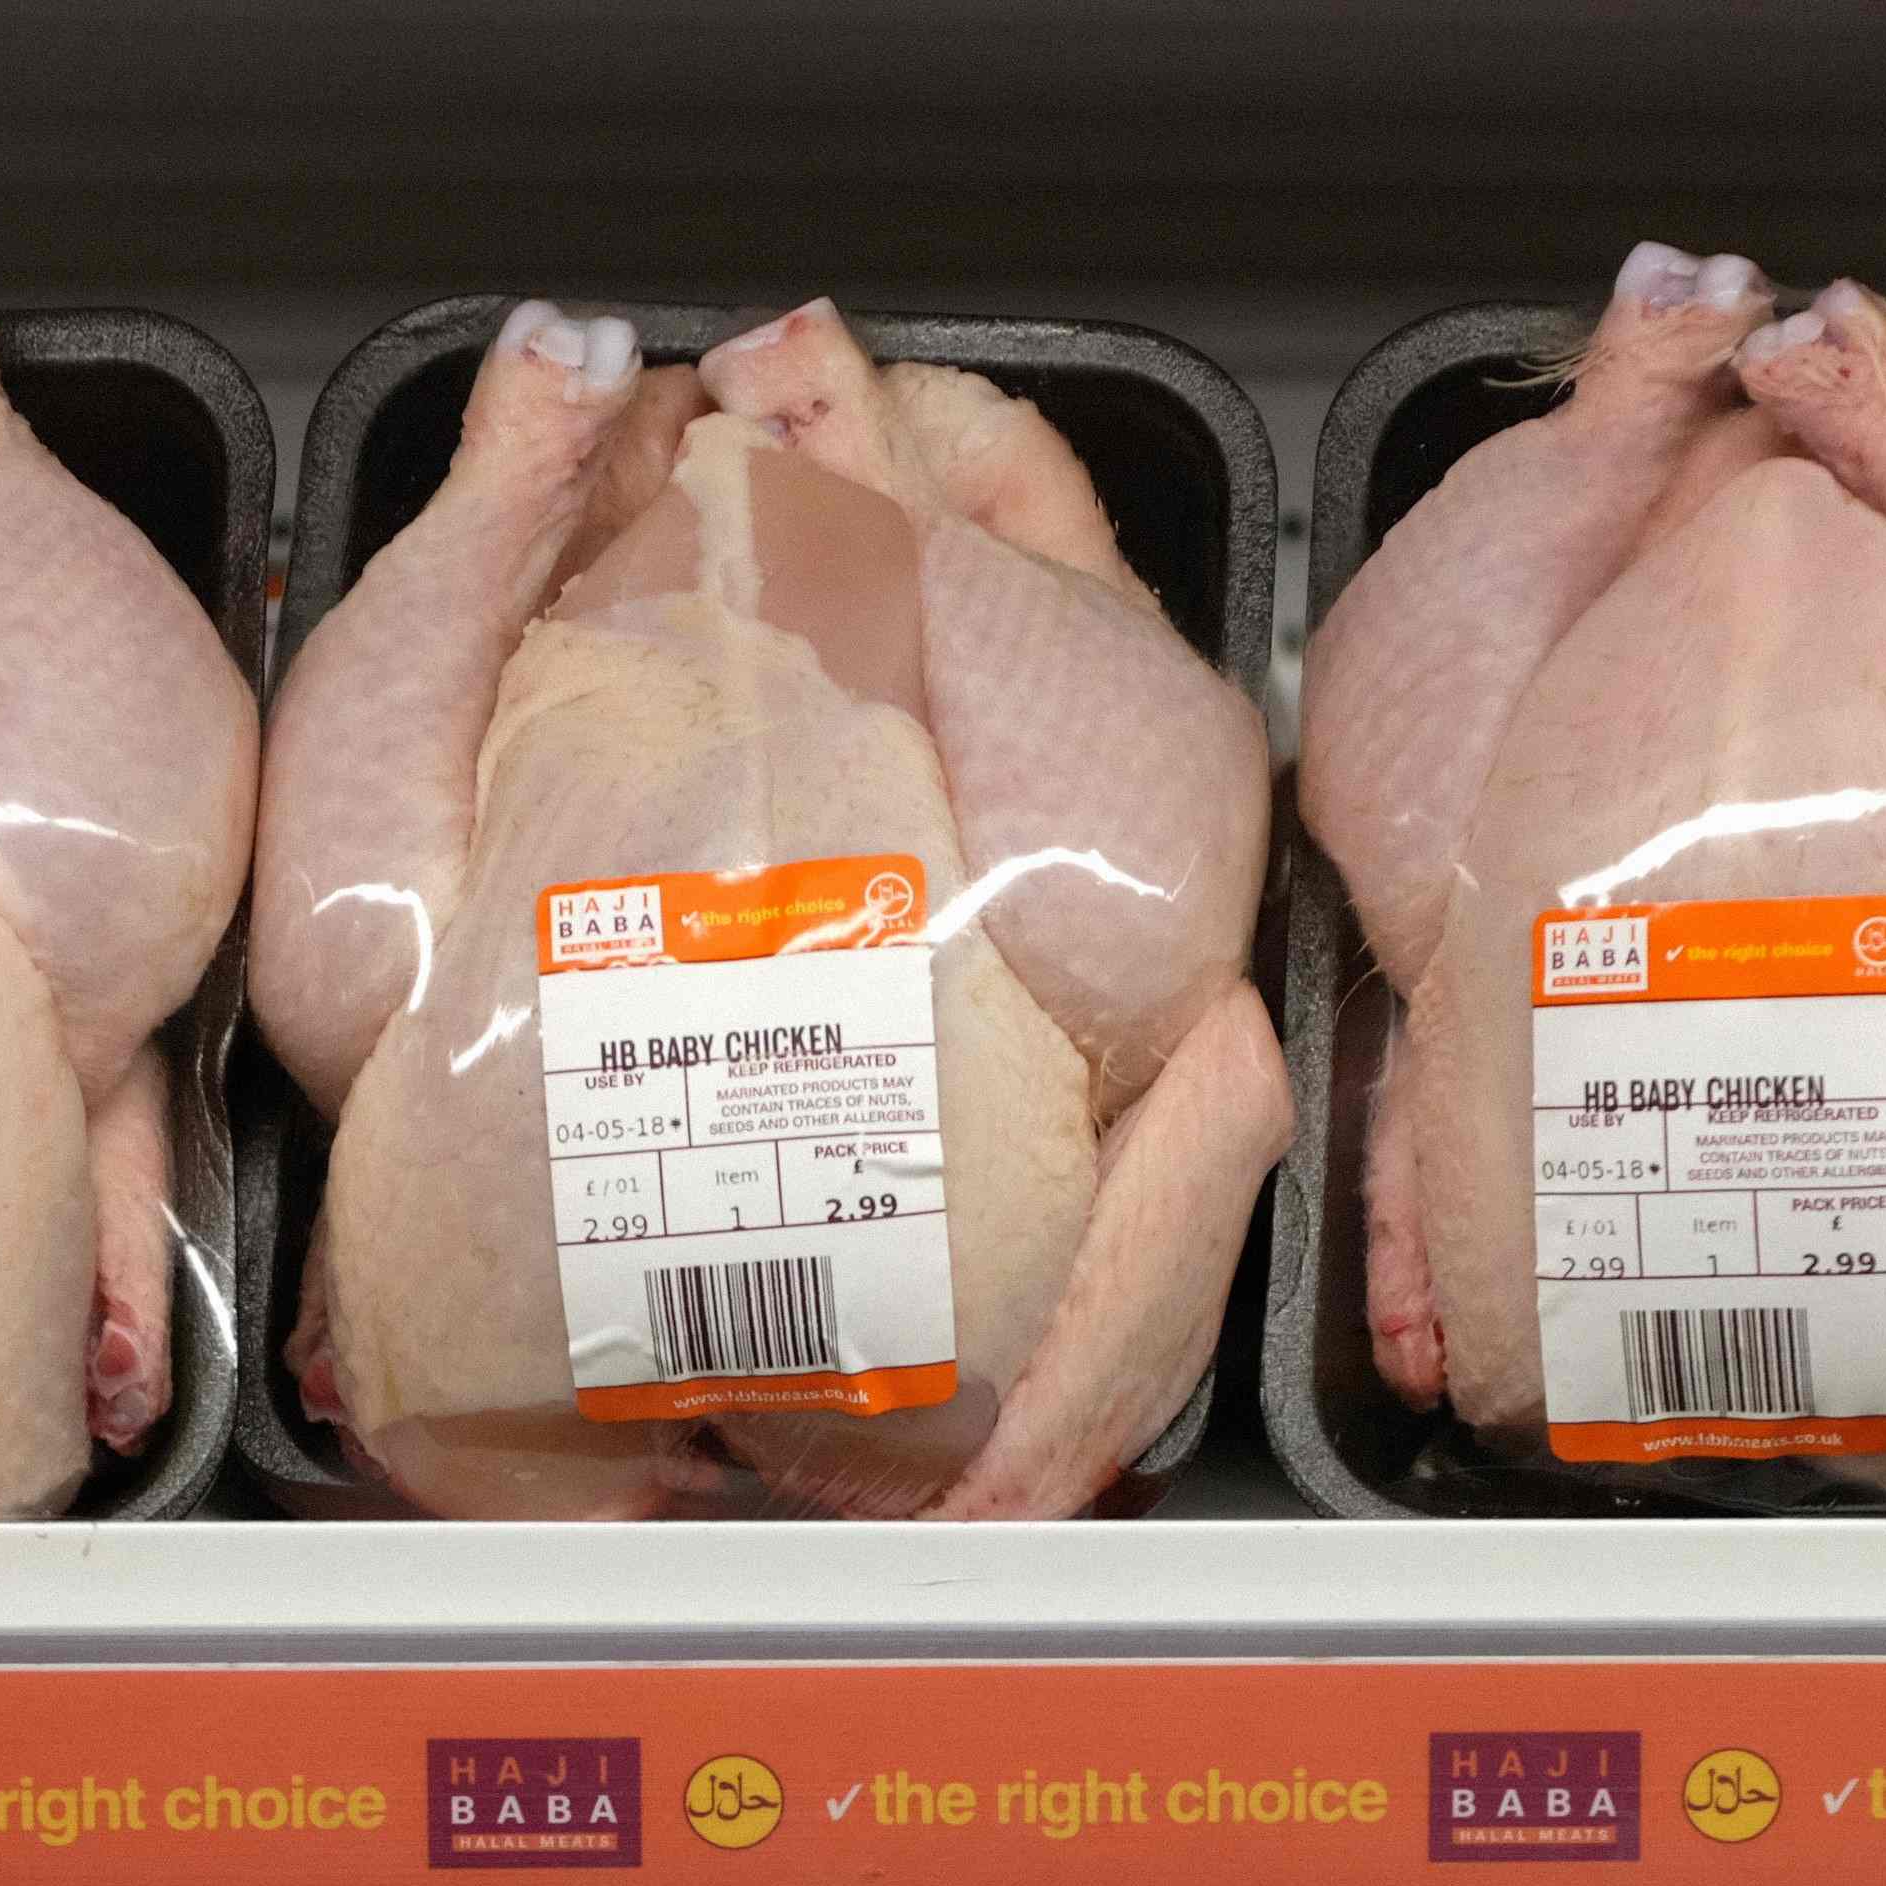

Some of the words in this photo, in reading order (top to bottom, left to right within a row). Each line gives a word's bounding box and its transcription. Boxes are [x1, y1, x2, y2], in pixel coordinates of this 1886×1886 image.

[558, 893, 650, 917] HAJI
[702, 909, 732, 926] the
[738, 906, 779, 928] right
[559, 913, 653, 939] BABA
[1552, 927, 1636, 946] HAJI
[1552, 948, 1640, 970] BABA
[600, 1040, 636, 1072] HB
[649, 1035, 713, 1068] BABY
[725, 1023, 843, 1063] CHICKEN
[727, 1062, 769, 1078] KEEP
[774, 1053, 897, 1074] REFRIGERATED
[585, 1075, 618, 1090] USE
[623, 1073, 644, 1088] BY
[716, 1084, 799, 1101] MARINATED
[802, 1080, 878, 1094] PRODUCTS
[882, 1076, 914, 1089] MAY
[1584, 1081, 1619, 1112] HB
[1630, 1079, 1696, 1112] BABY
[1707, 1075, 1825, 1110] CHICKEN
[721, 1101, 782, 1117] CONTAIN
[786, 1098, 841, 1111] TRACES
[846, 1096, 865, 1108] OF
[1707, 1109, 1750, 1124] KEEP
[1754, 1106, 1879, 1123] REFRIGERATED
[709, 1120, 755, 1135] SEEDS
[759, 1118, 788, 1131] AND
[792, 1115, 840, 1129] OTHER
[843, 1108, 925, 1125] ALLERGENS
[1569, 1114, 1603, 1128] USE
[1606, 1114, 1625, 1127] BY
[814, 1144, 857, 1160] PACK
[863, 1142, 908, 1157] PRICE
[714, 1169, 759, 1185] Item
[825, 1194, 898, 1224] 2.99
[1791, 1198, 1835, 1210] PACK
[584, 1215, 648, 1243] 2.99
[732, 1206, 745, 1231] 1
[1693, 1218, 1738, 1233] Item
[1561, 1256, 1624, 1279] 2.99
[1803, 1252, 1876, 1276] 2.99
[451, 1756, 609, 1786] HAJI
[1452, 1749, 1609, 1779] HAJI
[164, 1775, 386, 1832] choice
[451, 1796, 618, 1825] BABA
[871, 1771, 977, 1825] the
[997, 1769, 1148, 1839] right
[1165, 1768, 1387, 1824] choice
[1453, 1789, 1616, 1818] BABA
[459, 1835, 528, 1850] HALAL
[540, 1835, 611, 1849] MEATS
[1460, 1829, 1527, 1843] HALAL
[1539, 1829, 1610, 1843] MEATS
